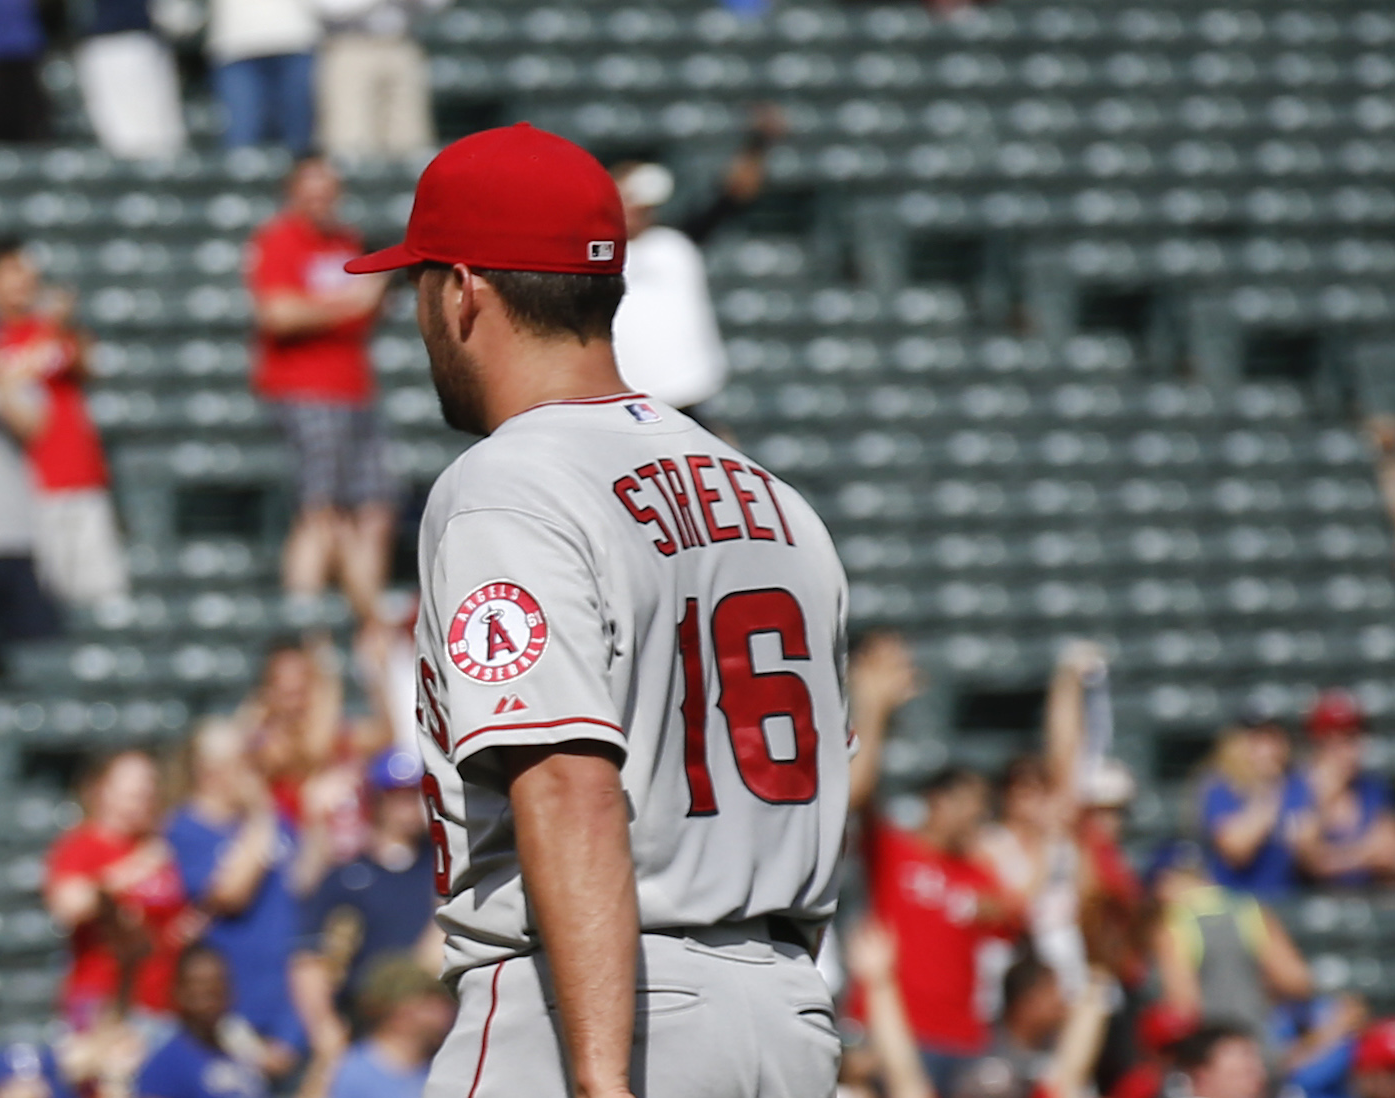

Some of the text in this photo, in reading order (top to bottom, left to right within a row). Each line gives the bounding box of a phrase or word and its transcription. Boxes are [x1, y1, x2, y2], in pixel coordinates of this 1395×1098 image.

[613, 454, 796, 556] STREET
[456, 584, 521, 622] ANGELS
[450, 639, 468, 655] 19
[480, 605, 519, 662] A
[457, 637, 545, 681] BASEBALL
[678, 587, 819, 817] 16
